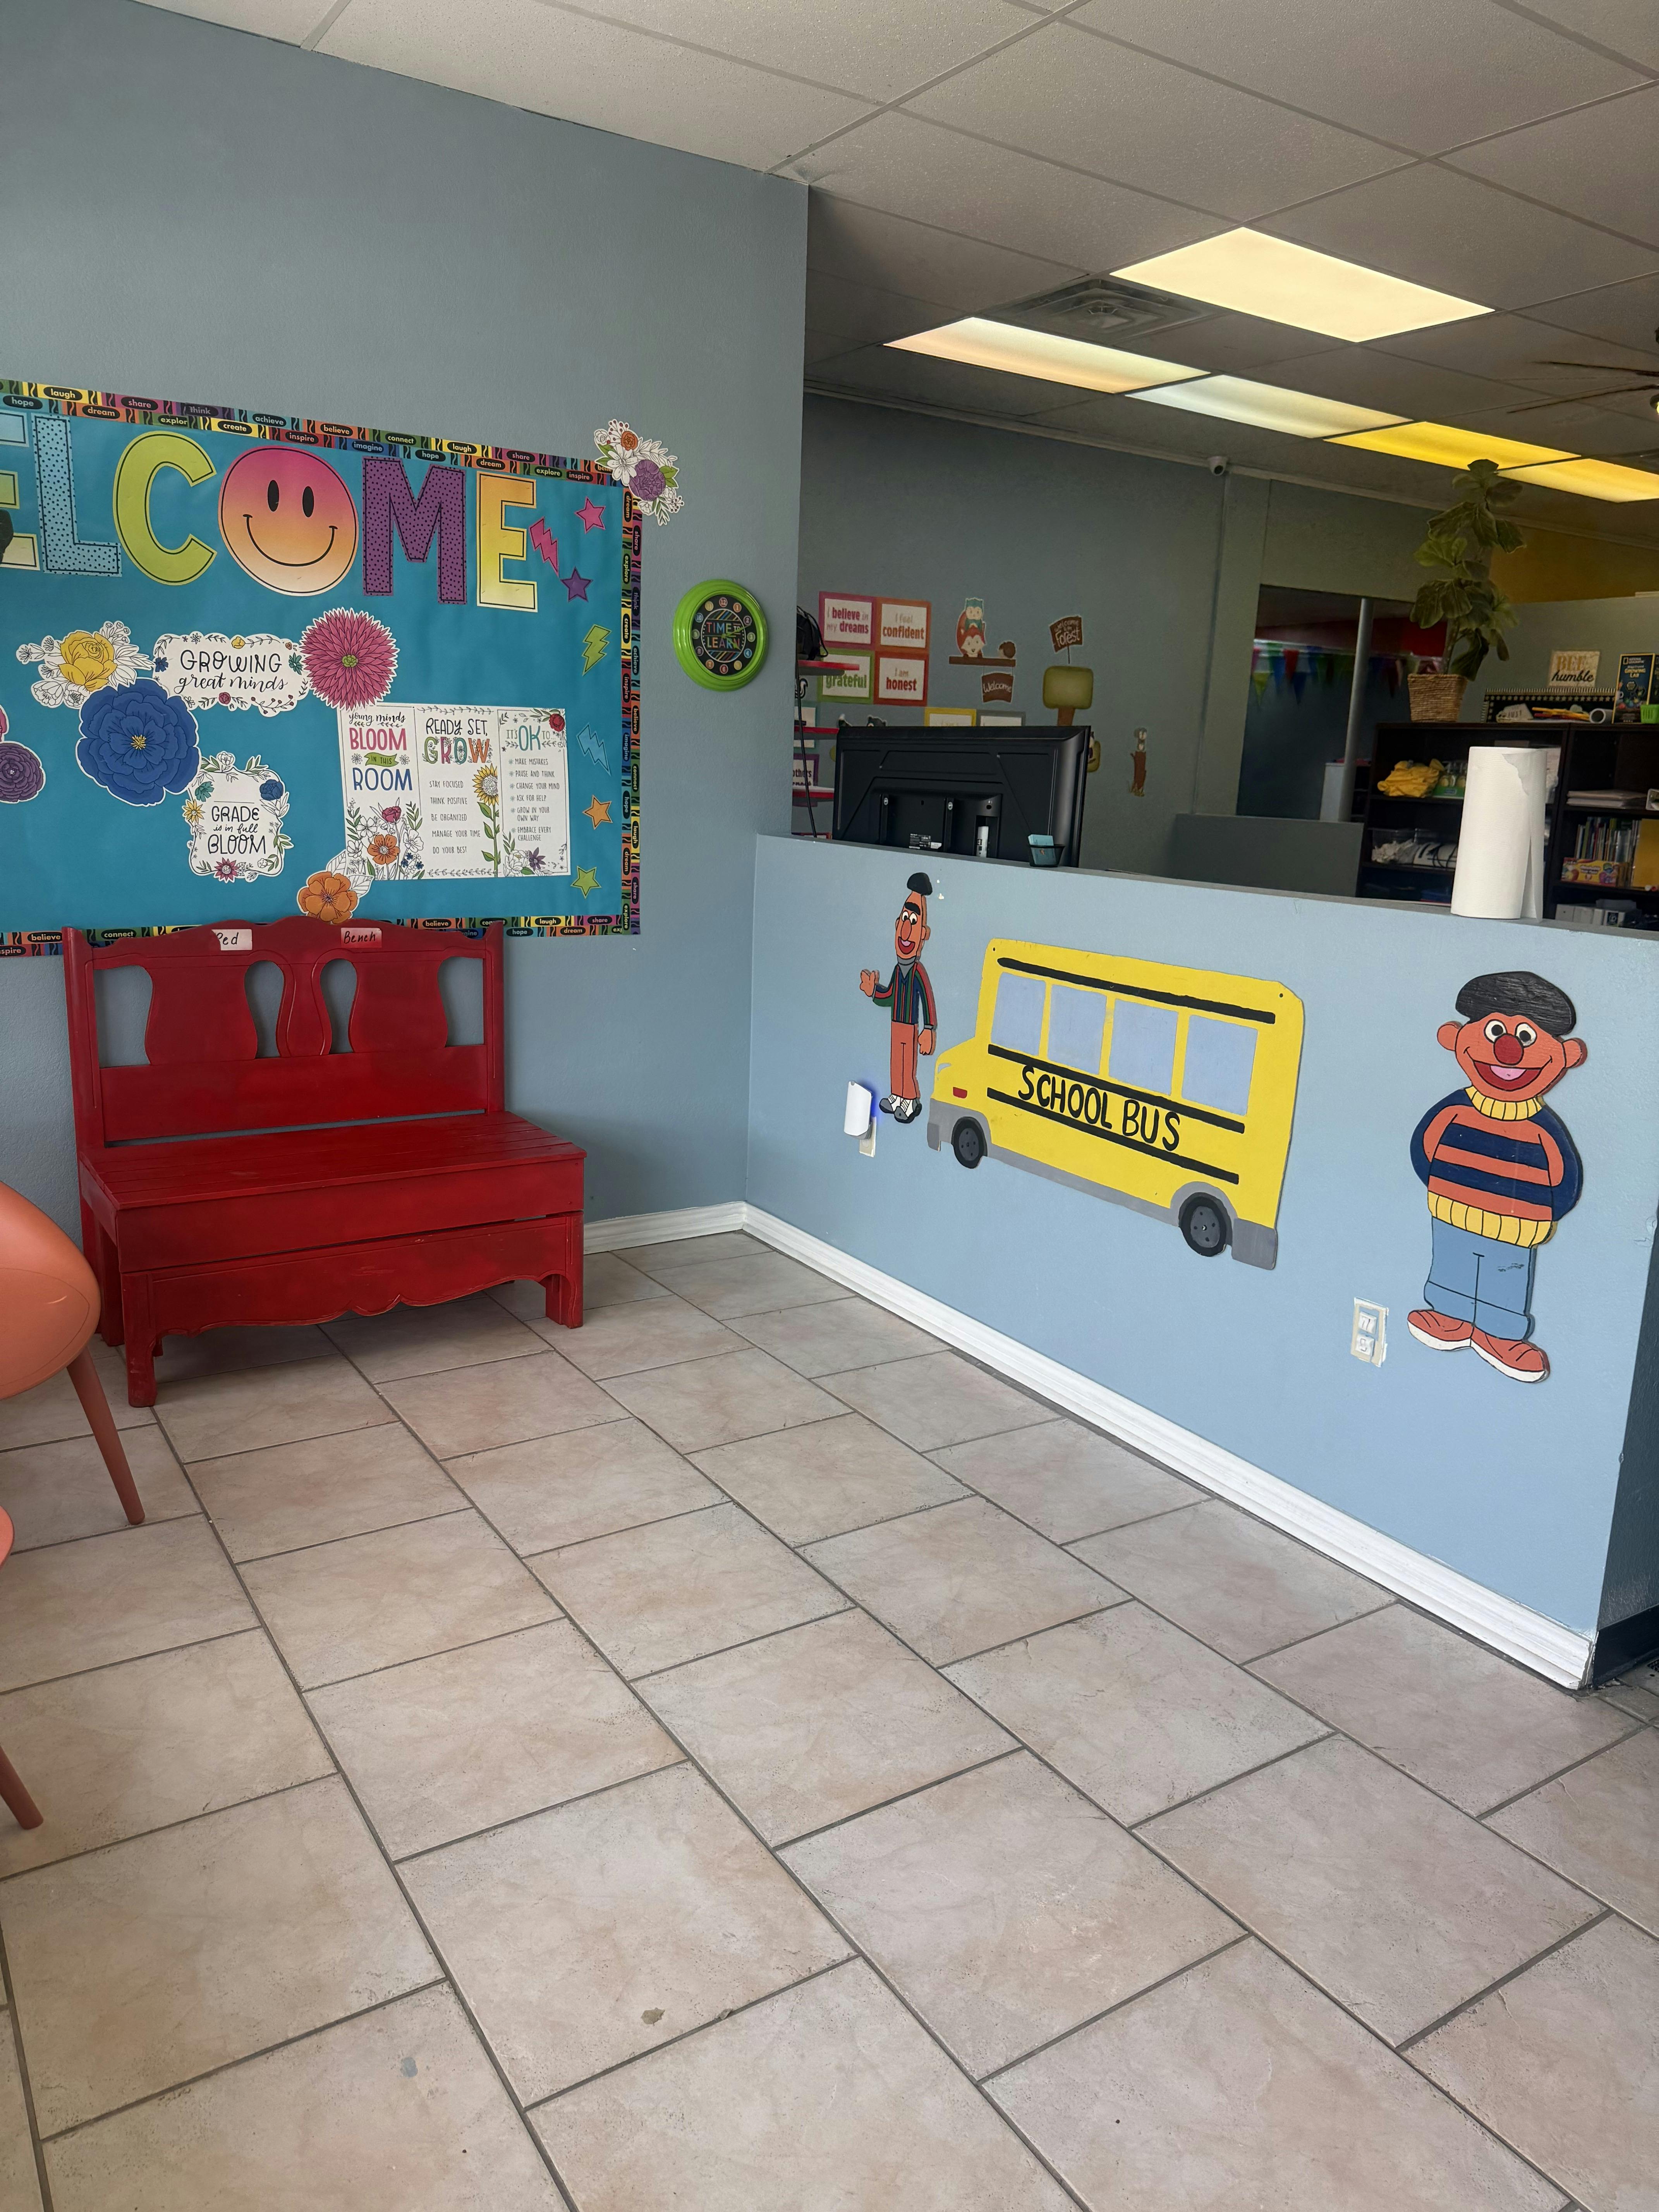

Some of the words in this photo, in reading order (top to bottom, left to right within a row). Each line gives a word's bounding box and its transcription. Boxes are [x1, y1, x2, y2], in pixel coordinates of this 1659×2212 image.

[51, 388, 76, 399] laugh
[11, 397, 34, 407] hope
[128, 399, 151, 408] share
[88, 407, 115, 416] dream
[160, 417, 188, 426] explor
[255, 416, 284, 425] achieve
[223, 423, 247, 432] create
[324, 425, 350, 434] believe
[289, 433, 314, 444] inspire
[388, 435, 414, 444] connect
[354, 441, 383, 452] imagine
[453, 443, 472, 453] laugh
[422, 450, 439, 459] hope
[480, 460, 501, 468] dream
[536, 468, 560, 477] explore
[832, 607, 860, 621] believe
[706, 622, 732, 634] TIME
[840, 620, 869, 634] dreams
[883, 625, 924, 639] confident
[1055, 626, 1080, 647] Forest
[707, 637, 740, 649] LEARN
[180, 649, 282, 673] GROWING
[1557, 656, 1586, 671] BEE
[1551, 670, 1594, 682] humble
[173, 672, 226, 694] great
[230, 676, 288, 692] minds
[886, 677, 917, 691] honest
[983, 680, 1012, 693] Welcome
[349, 712, 374, 726] young
[376, 712, 406, 723] minds
[467, 719, 488, 736] SET,
[349, 727, 407, 750] BLOOM
[506, 729, 518, 739] IT'S
[519, 725, 541, 751] OK
[424, 736, 490, 765] GROW
[381, 757, 392, 765] THIS
[352, 767, 413, 791] ROOM
[211, 805, 260, 822] GRADE
[213, 824, 222, 832] is
[225, 824, 233, 833] in
[237, 823, 258, 834] full
[208, 834, 266, 854] BLOOM
[344, 931, 376, 944] Bench
[1018, 1065, 1112, 1130] SCHOOL
[1122, 1099, 1180, 1151] BUS
